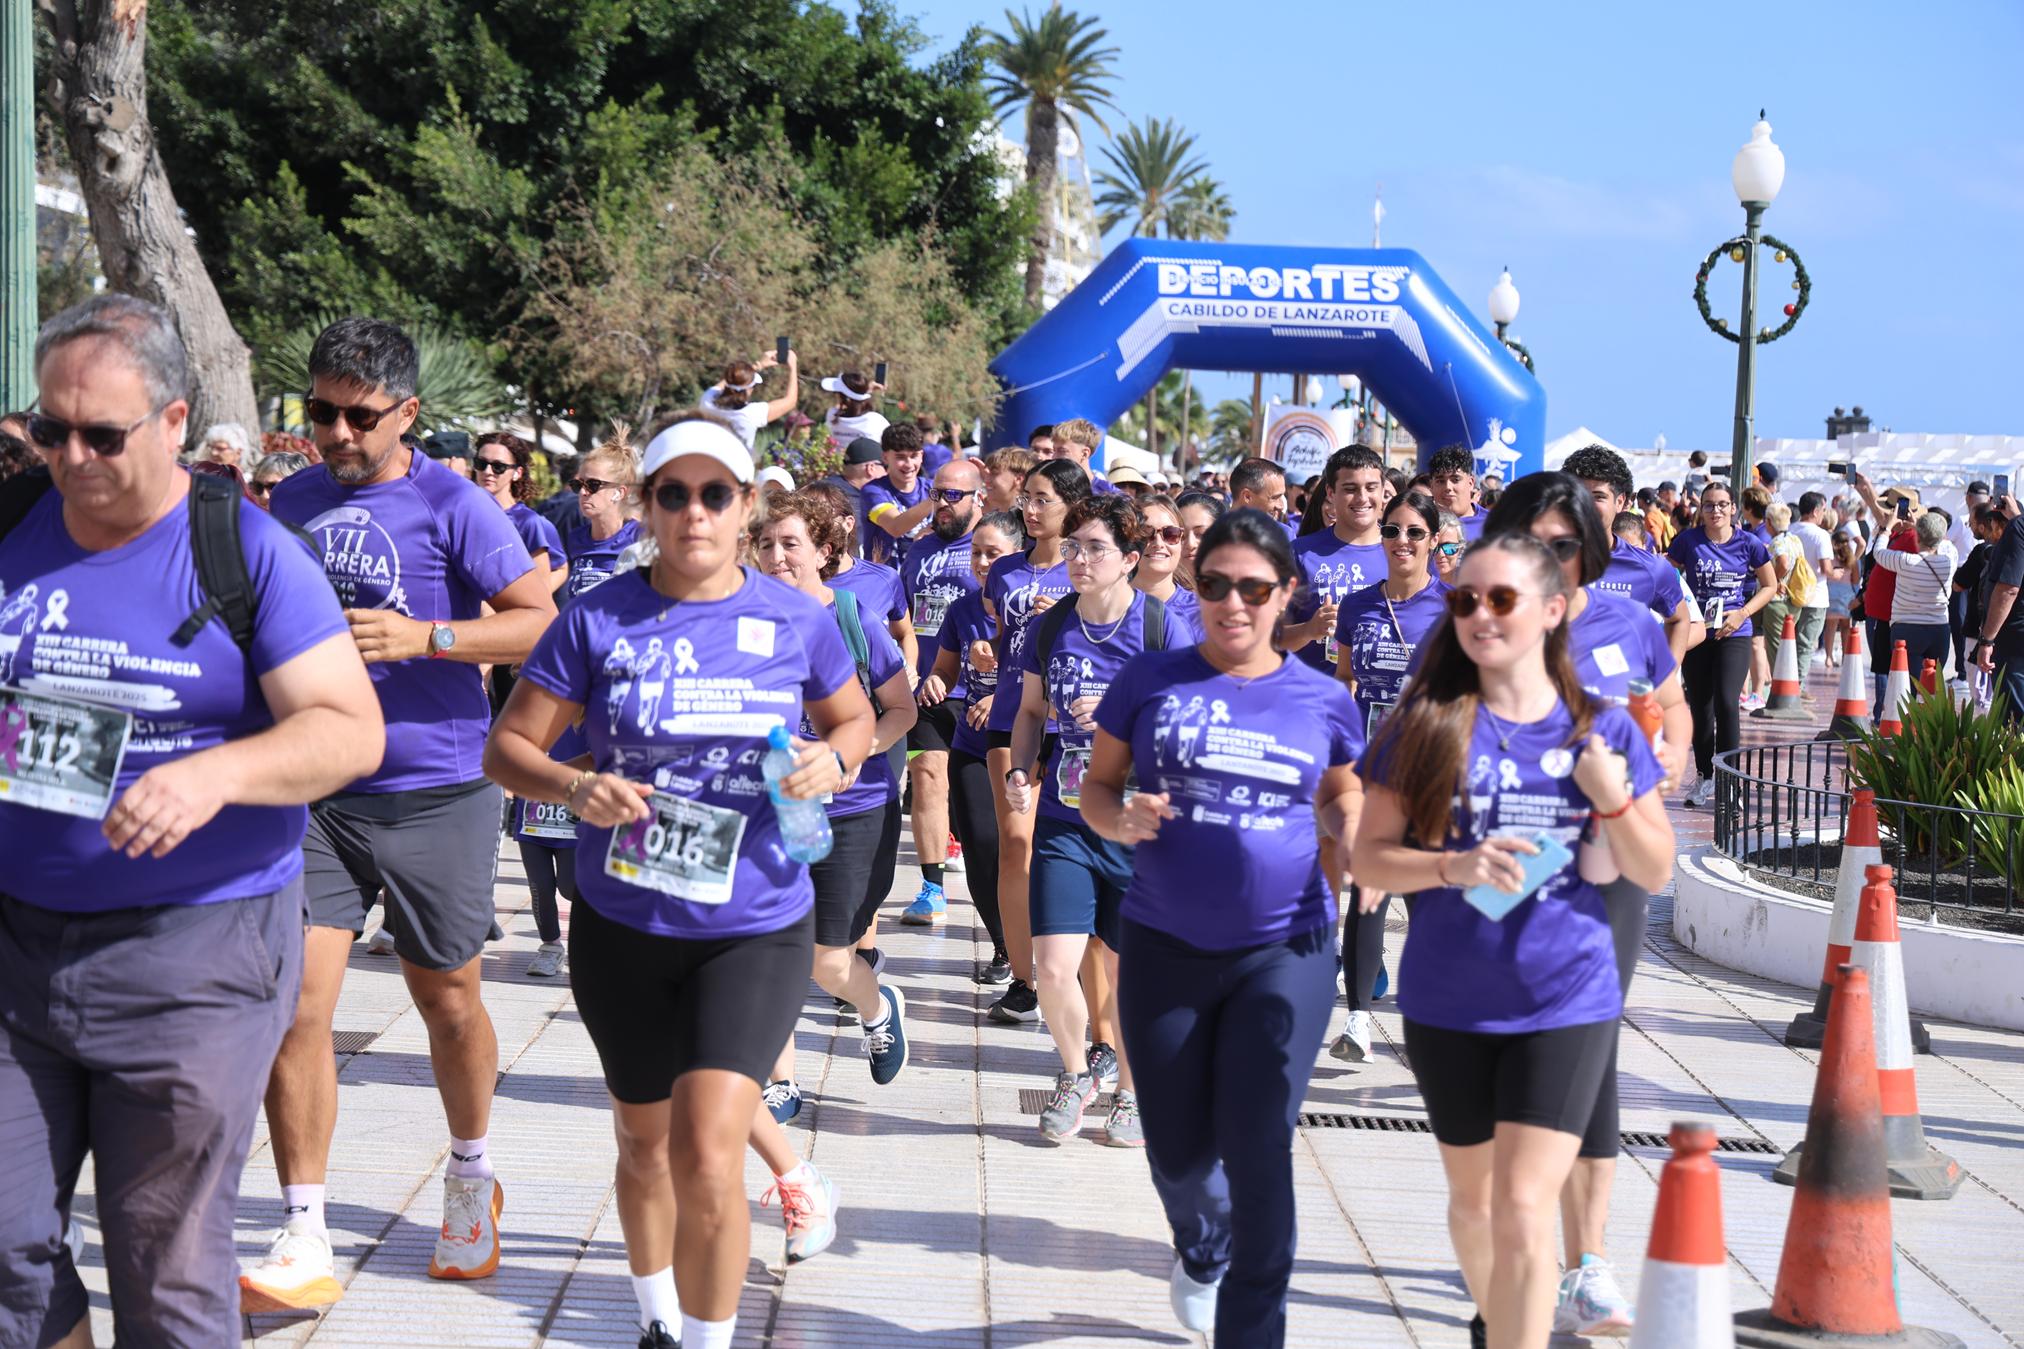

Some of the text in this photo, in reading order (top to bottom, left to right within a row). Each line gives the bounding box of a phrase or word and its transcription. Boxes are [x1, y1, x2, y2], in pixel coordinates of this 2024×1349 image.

[1157, 264, 1399, 302] DEPORTES
[1168, 304, 1391, 324] CABILDO DE LANZAROTE
[323, 527, 370, 554] VII
[323, 551, 391, 577] RRERA
[363, 577, 391, 586] GÉNERO
[1042, 586, 1072, 594] Contra
[1600, 580, 1632, 591] Contra
[925, 608, 944, 621] 016
[36, 634, 128, 655] XIII CARRERA
[32, 658, 111, 679] DE GÉNERO
[33, 647, 203, 678] CONTRA LA VIOLENCIA
[53, 683, 121, 699] LANZAROTE
[697, 678, 754, 690] CARRERA
[673, 689, 796, 704] CONTRA LA VIOLENCIA
[672, 700, 743, 713] DE GÉNERO
[1206, 734, 1249, 748] CONTRA
[1227, 728, 1276, 746] CARRERA
[16, 729, 81, 773] 112
[536, 804, 567, 821] 016
[643, 824, 704, 867] 016
